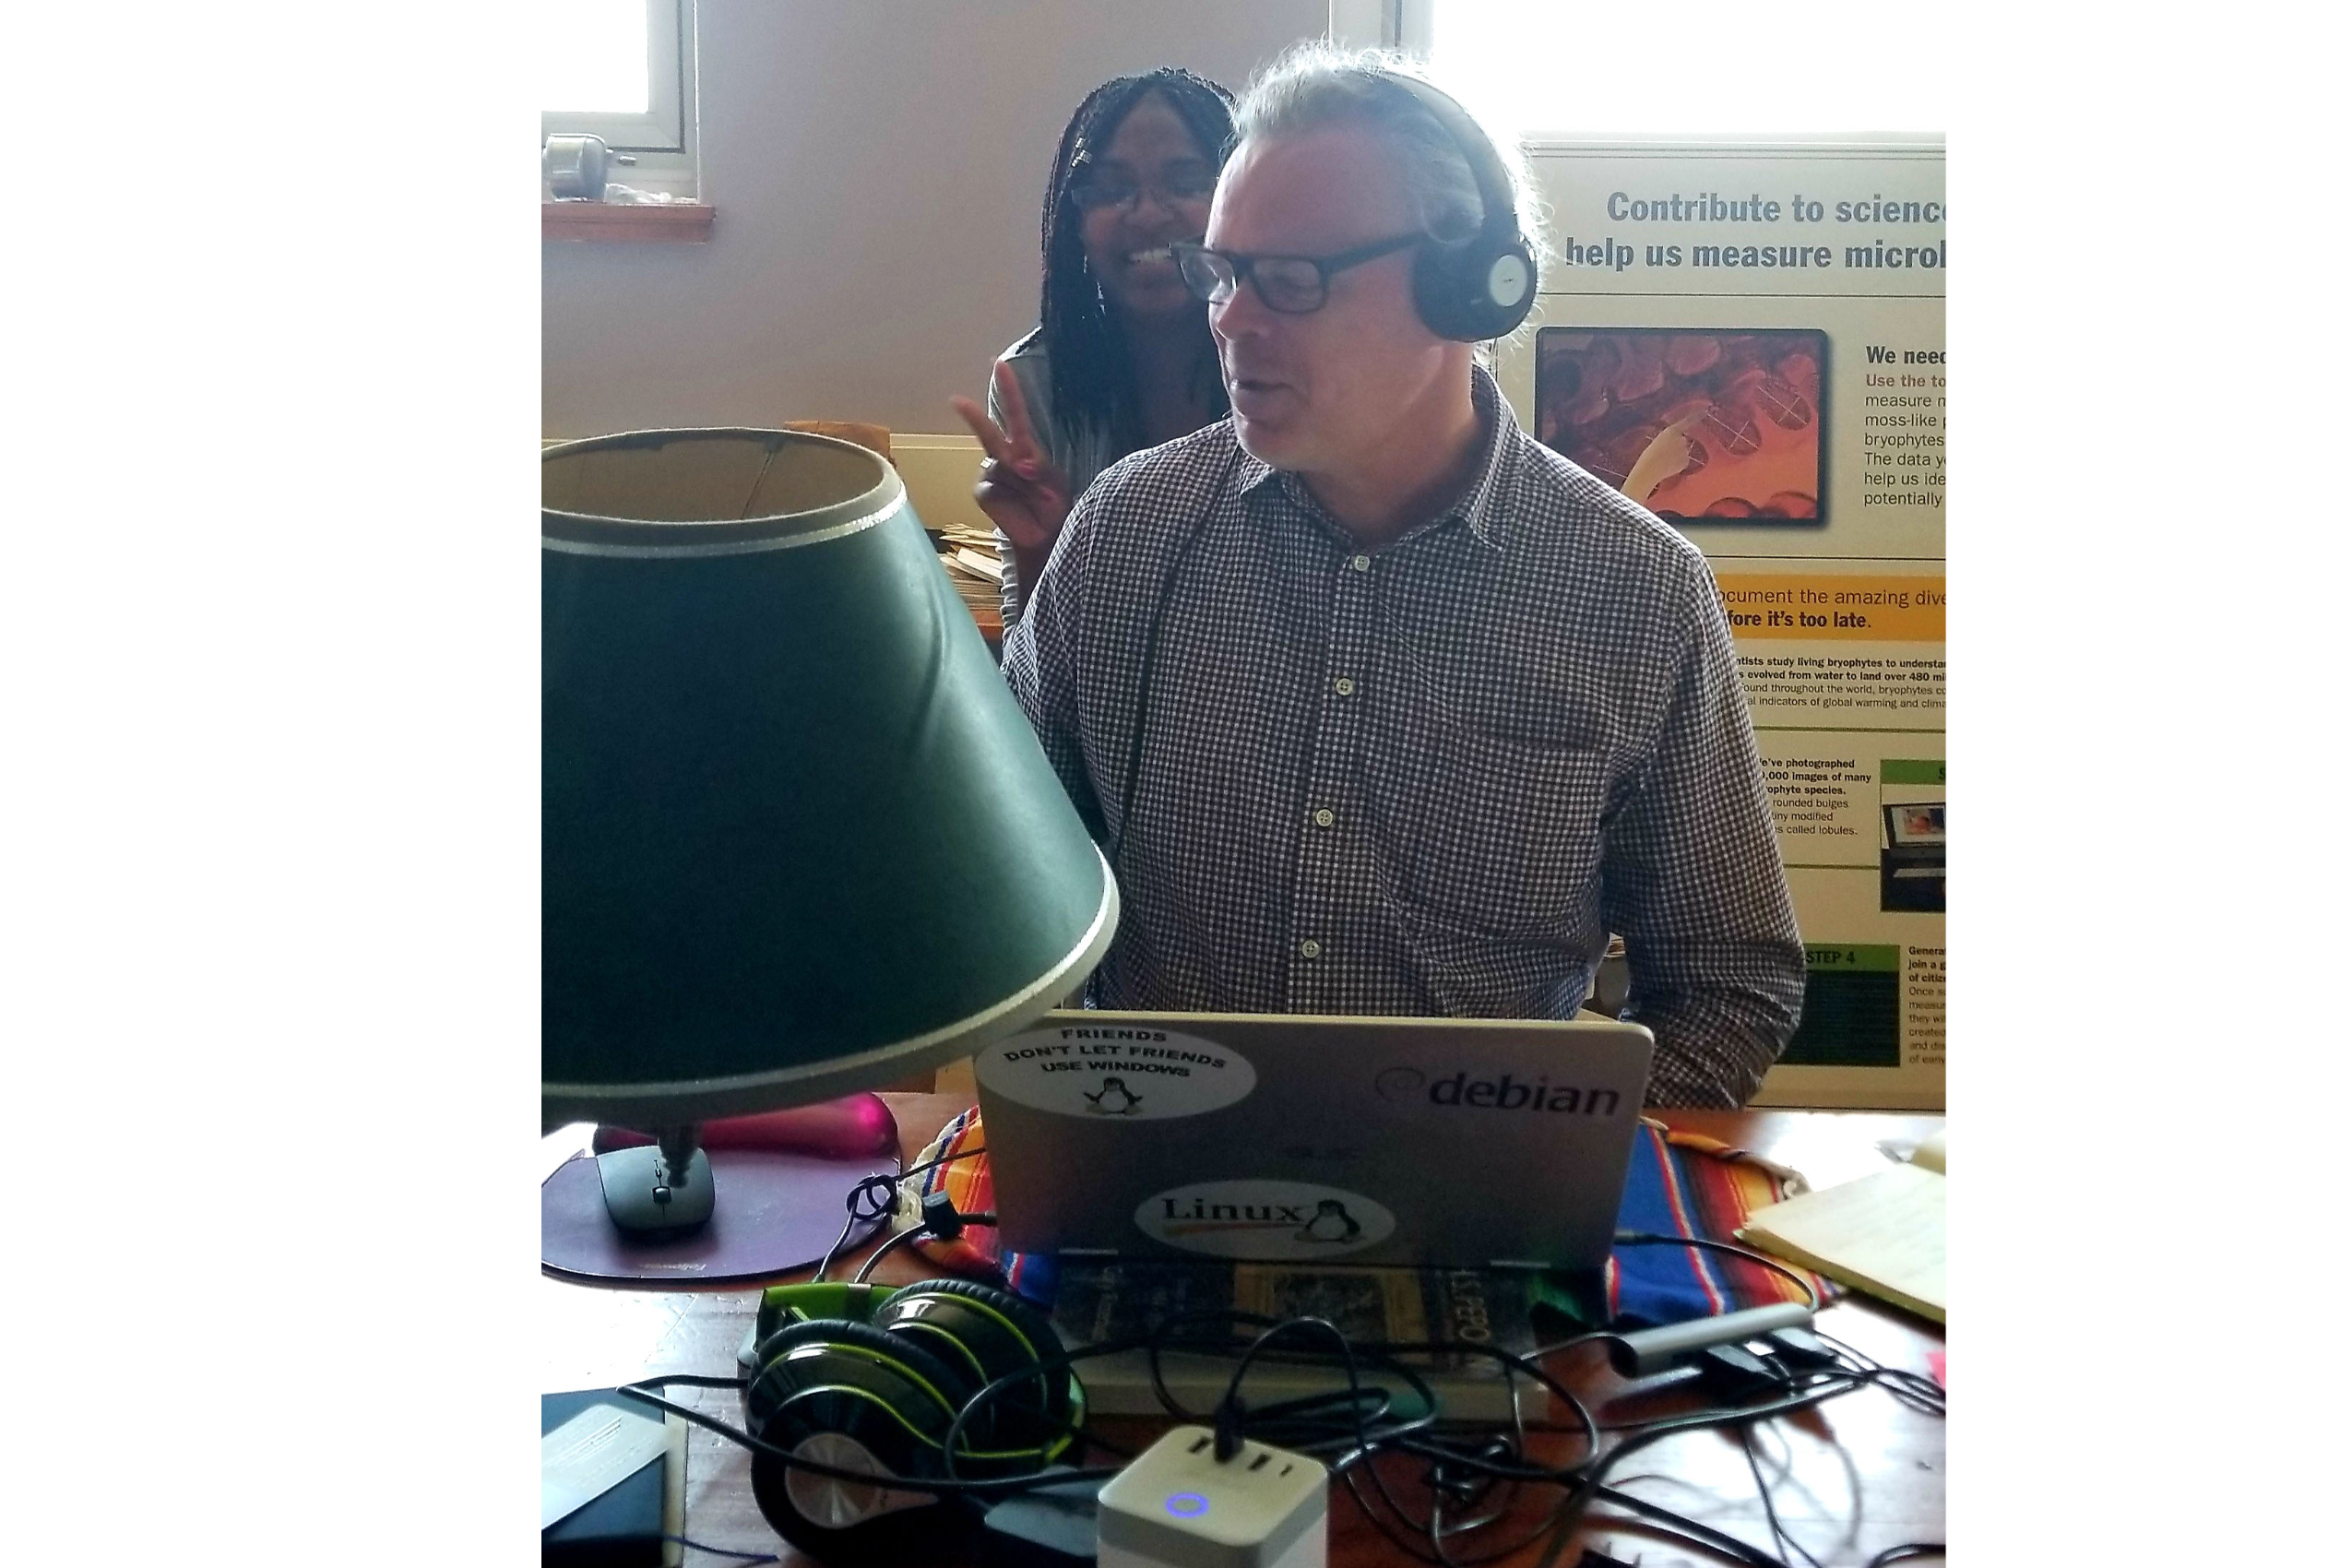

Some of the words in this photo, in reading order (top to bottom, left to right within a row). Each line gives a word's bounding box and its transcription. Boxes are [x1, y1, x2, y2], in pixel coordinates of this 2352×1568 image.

[1608, 192, 1781, 222] Contribute
[1792, 194, 1824, 222] to
[1835, 193, 1945, 223] scienc
[1566, 236, 1634, 272] help
[1646, 245, 1682, 267] us
[1693, 245, 1832, 268] measure
[1865, 345, 1896, 364] We
[1866, 374, 1895, 387] Use
[1900, 374, 1926, 387] the
[1865, 396, 1931, 408] measure
[1865, 413, 1937, 427] moss-like
[1865, 432, 1944, 449] bryophytes
[1864, 451, 1892, 466] The
[1896, 453, 1930, 466] data
[1936, 455, 1945, 469] y
[1864, 471, 1895, 488] help
[1901, 474, 1919, 485] us
[1864, 492, 1942, 508] potentially
[1800, 589, 1829, 604] the
[1835, 589, 1909, 609] amazing
[1800, 612, 1828, 627] too
[1834, 611, 1871, 628] late.
[1767, 657, 1795, 668] study
[1798, 658, 1824, 668] living
[1827, 658, 1883, 669] bryophytes
[1885, 659, 1896, 668] to
[1748, 670, 1786, 679] evolved
[1788, 671, 1812, 680] from
[1814, 671, 1844, 680] water
[1846, 671, 1857, 681] to
[1859, 671, 1882, 681] land
[1884, 673, 1907, 682] over
[1909, 672, 1930, 682] 480
[1742, 683, 1768, 693] ound
[1771, 683, 1824, 695] throughout
[1827, 684, 1843, 694] the
[1846, 684, 1875, 695] world,
[1879, 685, 1932, 696] bryophytes
[1759, 696, 1808, 707] indicators
[1810, 697, 1820, 707] of
[1823, 698, 1853, 709] global
[1856, 700, 1897, 710] warming
[1900, 699, 1918, 708] and
[1759, 757, 1783, 767] e've
[1786, 759, 1856, 770] photographed
[1792, 772, 1829, 783] images
[1832, 773, 1842, 781] of
[1844, 774, 1871, 784] many
[1804, 786, 1847, 796] species.
[1773, 799, 1813, 808] rounded
[1816, 800, 1849, 810] bulges
[1791, 813, 1834, 822] modified
[1787, 826, 1816, 835] called
[1819, 826, 1859, 836] lobules.
[1805, 951, 1841, 963] STEP
[1847, 951, 1855, 964] 4
[1908, 973, 1918, 982] of
[1908, 987, 1935, 996] Once
[1908, 1015, 1930, 1024] they
[1061, 1028, 1169, 1042] FRIENDS
[1909, 1041, 1929, 1051] and
[1003, 1045, 1071, 1062] DON'T
[1078, 1044, 1123, 1055] LET
[1128, 1046, 1228, 1069] FRIENDS
[1040, 1061, 1084, 1073] USE
[1087, 1061, 1192, 1077] WINDOWS
[1430, 1072, 1621, 1116] debian
[1163, 1198, 1311, 1222] Linux
